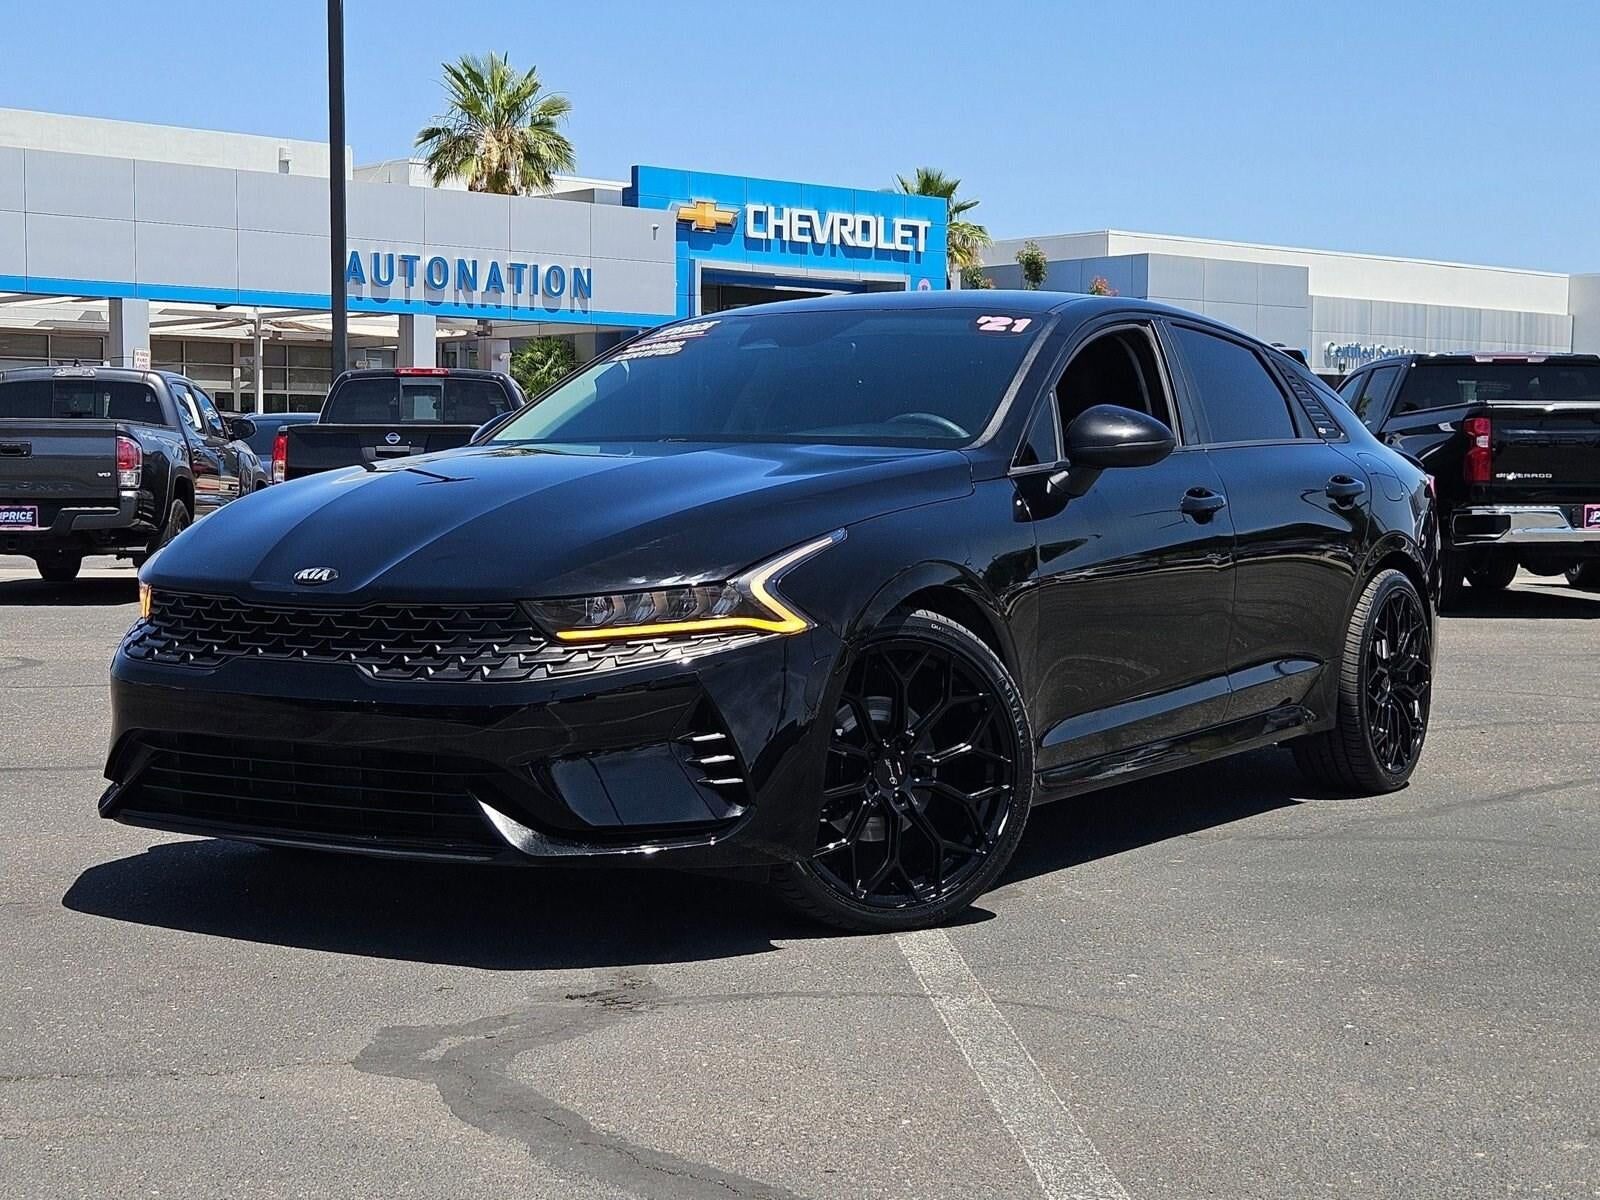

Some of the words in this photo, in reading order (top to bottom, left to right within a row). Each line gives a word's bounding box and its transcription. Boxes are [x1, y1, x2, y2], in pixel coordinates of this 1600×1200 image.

[745, 204, 931, 252] CHEVROLET
[346, 250, 592, 299] AUTONATION
[977, 316, 1032, 332] 21
[1326, 342, 1375, 358] Certified
[298, 569, 330, 581] KIA
